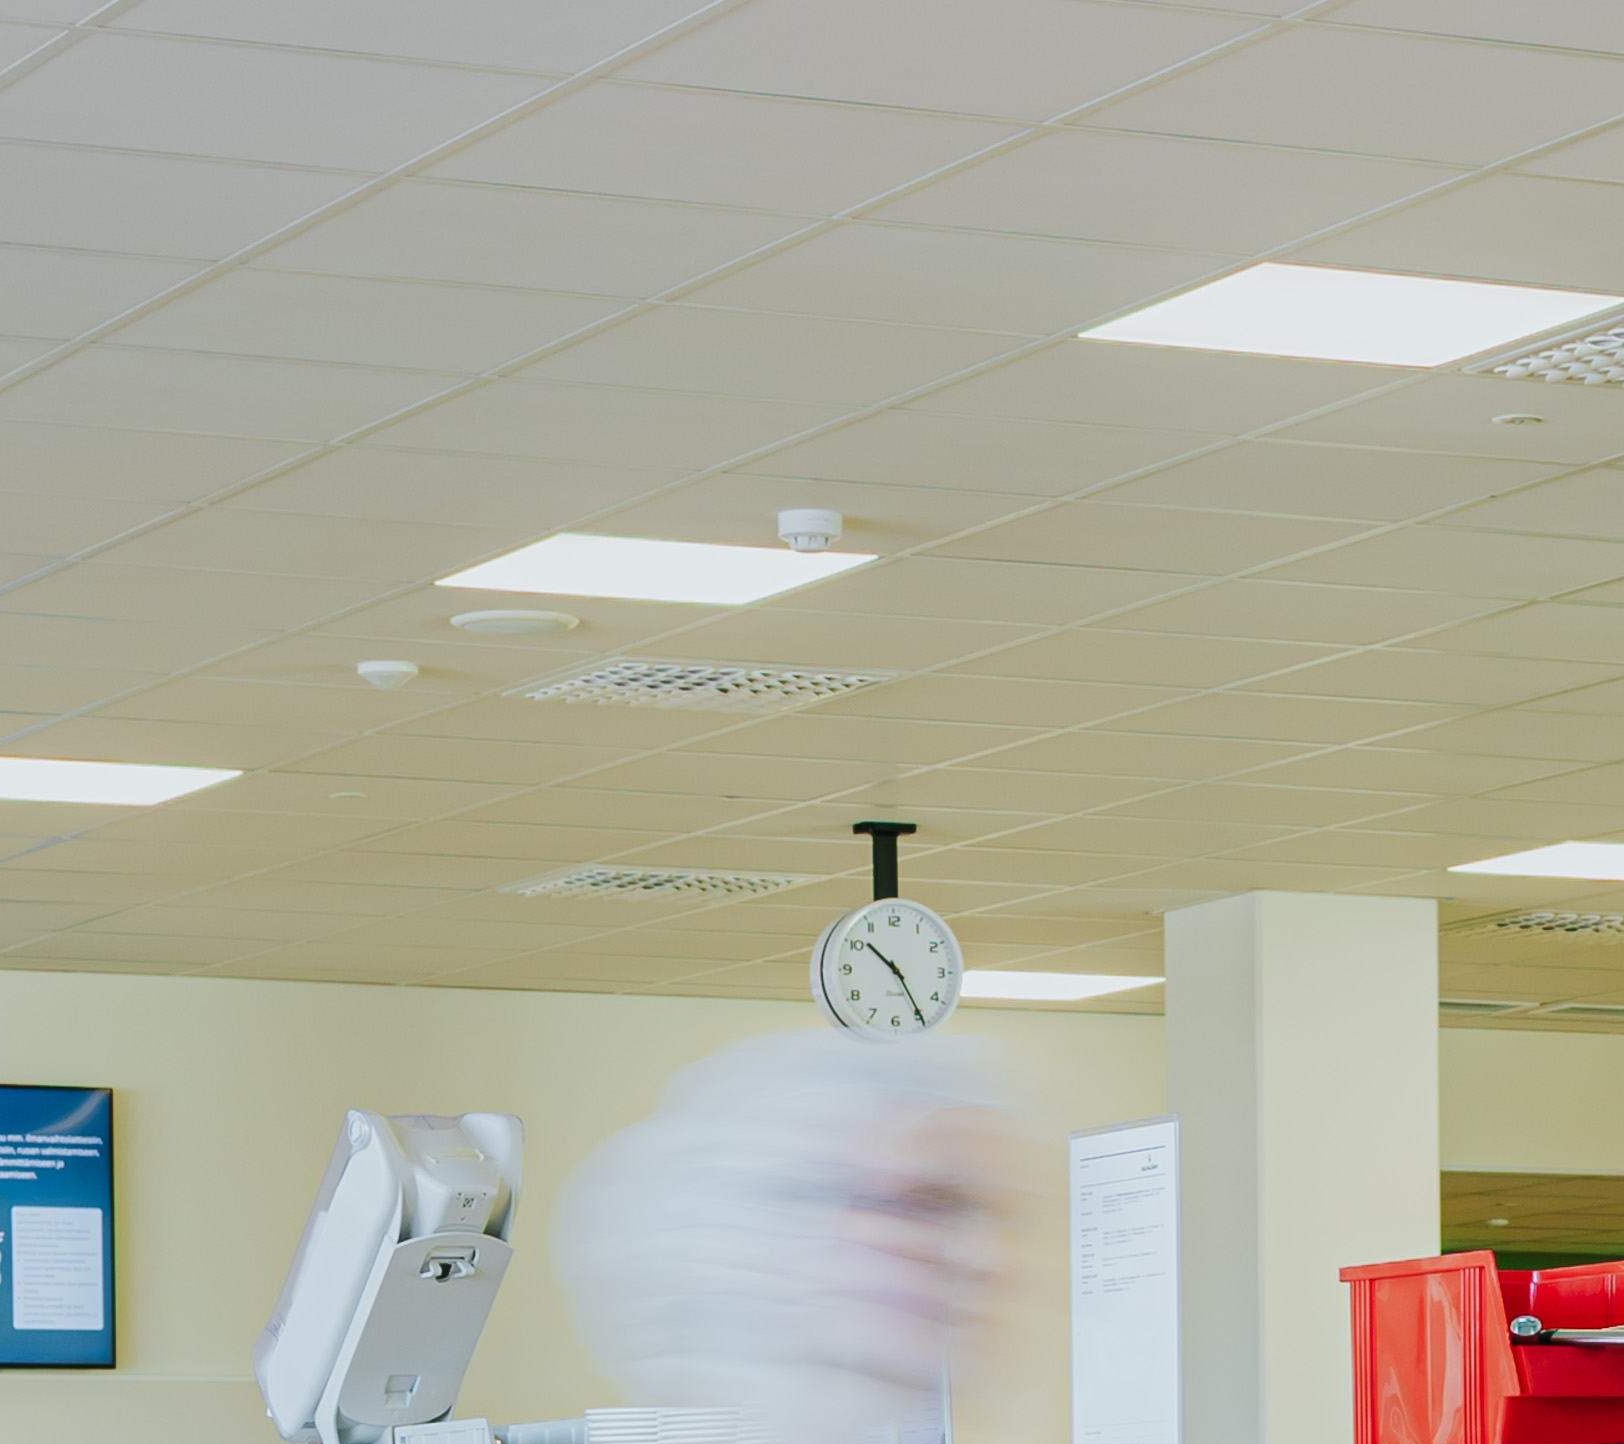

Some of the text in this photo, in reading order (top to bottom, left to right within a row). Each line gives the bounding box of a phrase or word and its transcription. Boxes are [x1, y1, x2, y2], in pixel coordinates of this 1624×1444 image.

[888, 916, 901, 927] 12
[867, 923, 874, 933] 11
[850, 940, 864, 951] 10
[929, 941, 938, 953] 2
[842, 965, 852, 975] 9
[937, 967, 945, 978] 3
[850, 990, 860, 1000] 8
[930, 992, 939, 1002] 4
[868, 1008, 877, 1019] 7
[891, 1016, 900, 1027] 6
